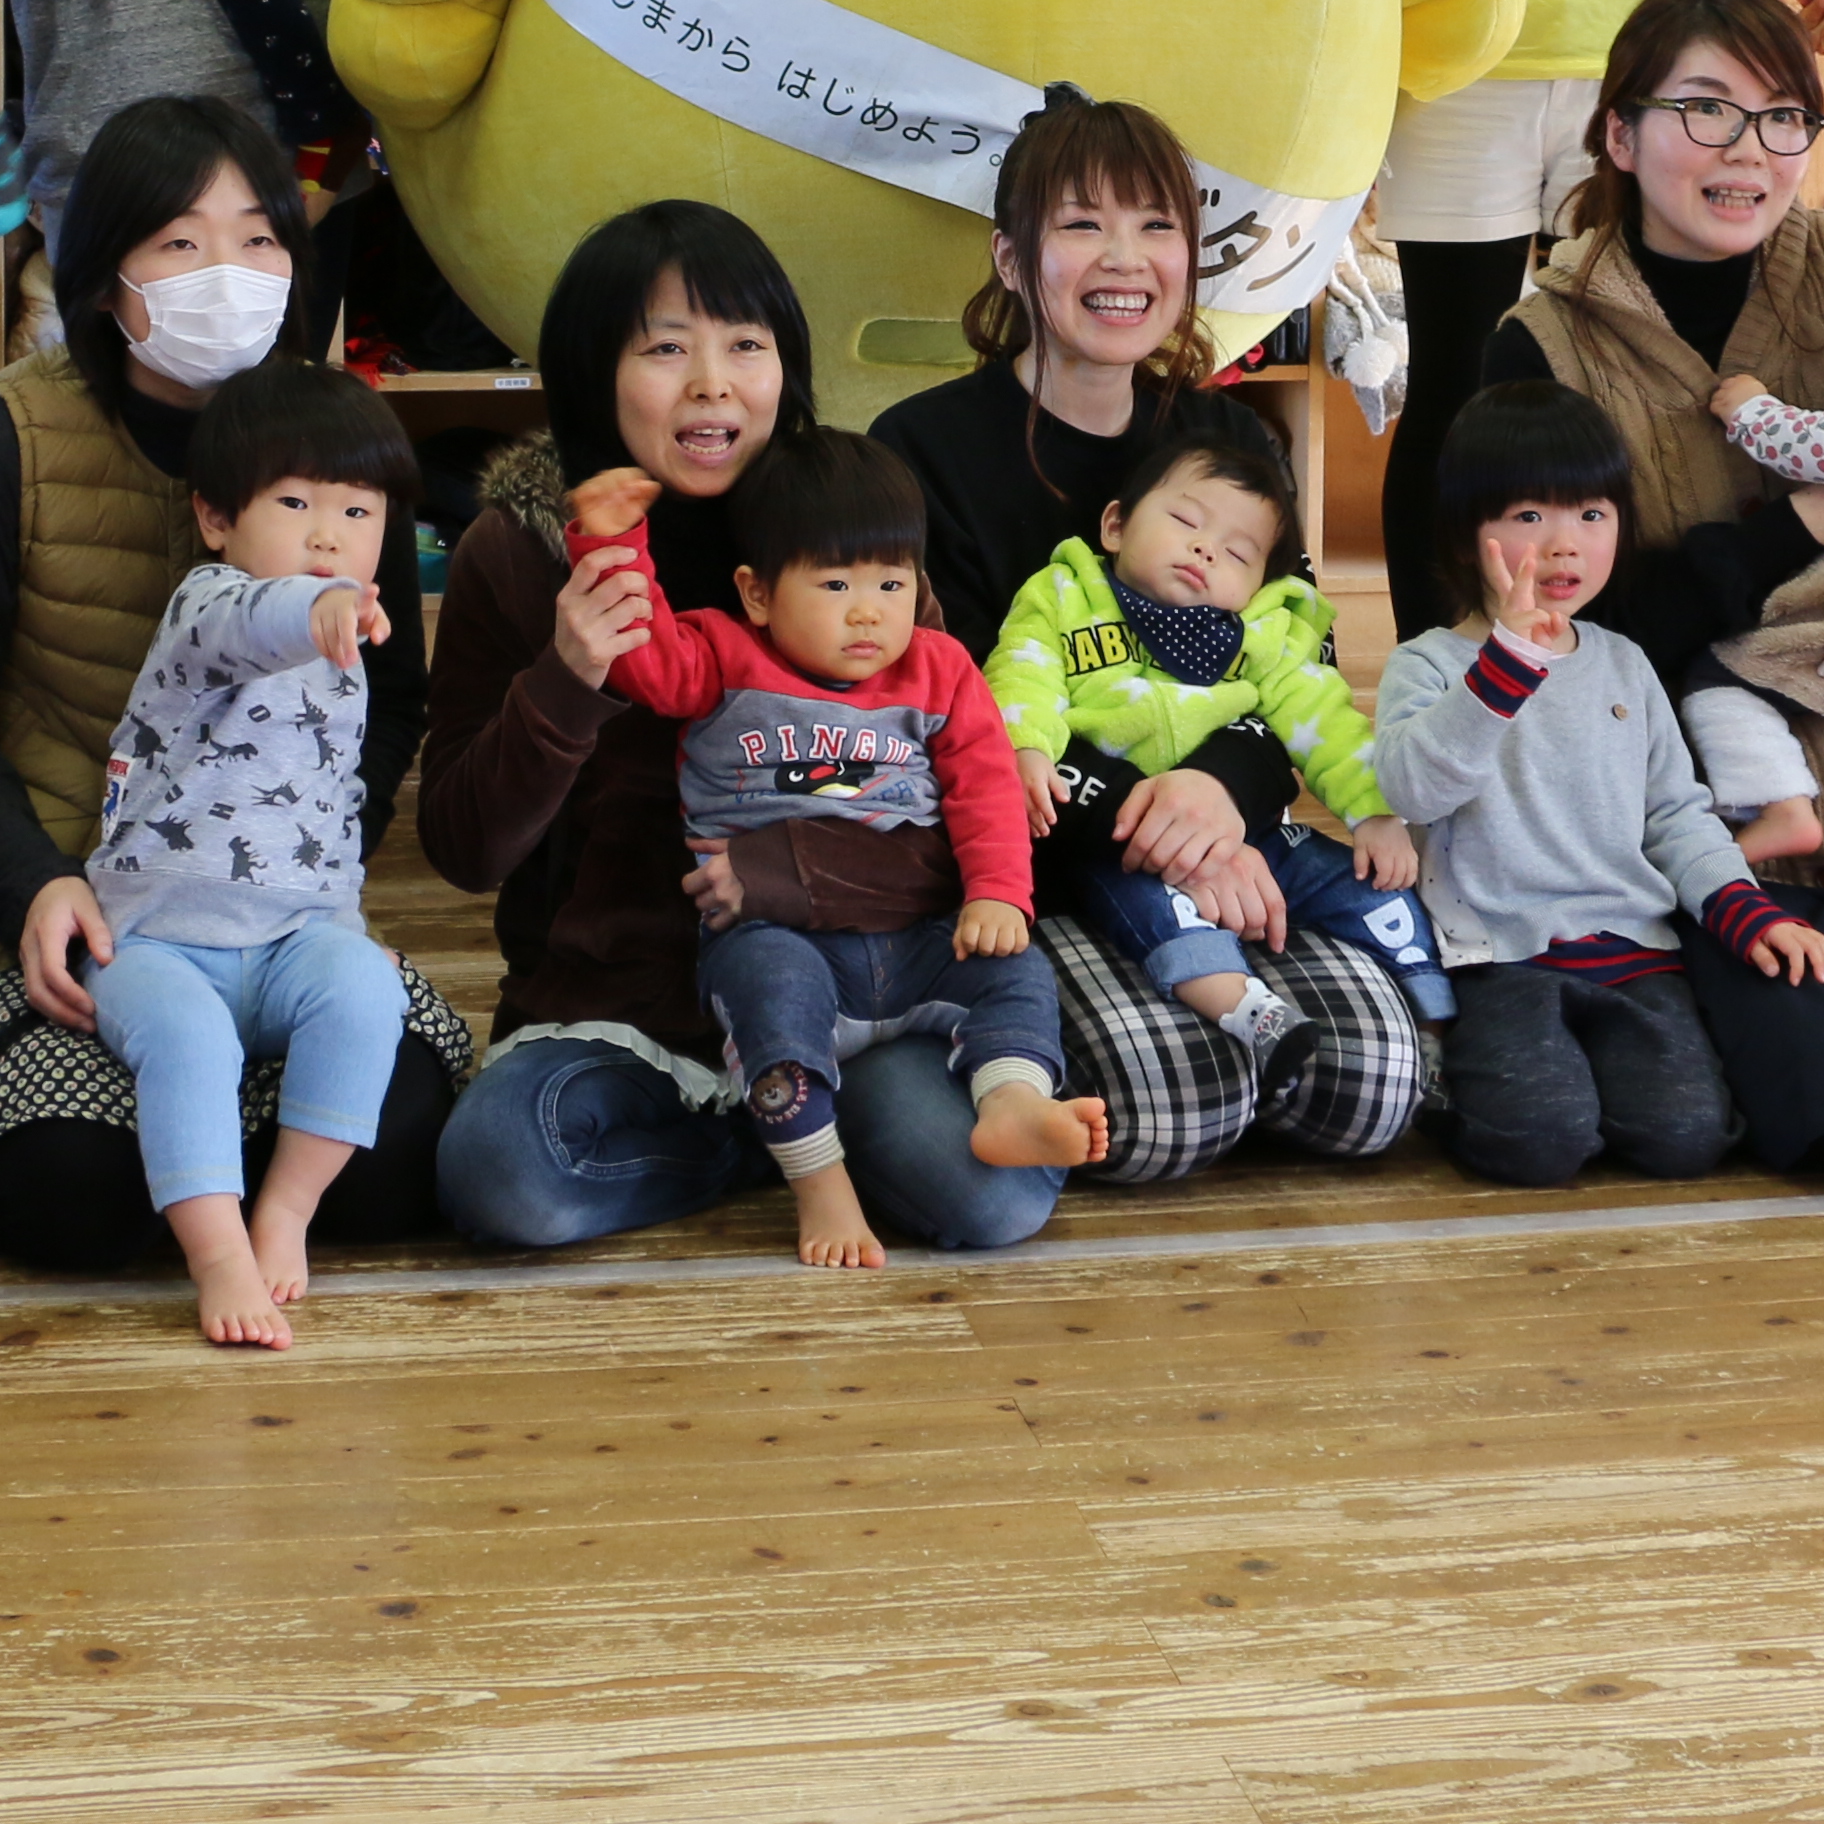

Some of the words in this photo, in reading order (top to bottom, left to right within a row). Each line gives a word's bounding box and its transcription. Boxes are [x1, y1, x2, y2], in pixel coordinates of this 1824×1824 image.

[776, 60, 1004, 168] はじめよう。
[1198, 188, 1317, 293] タン
